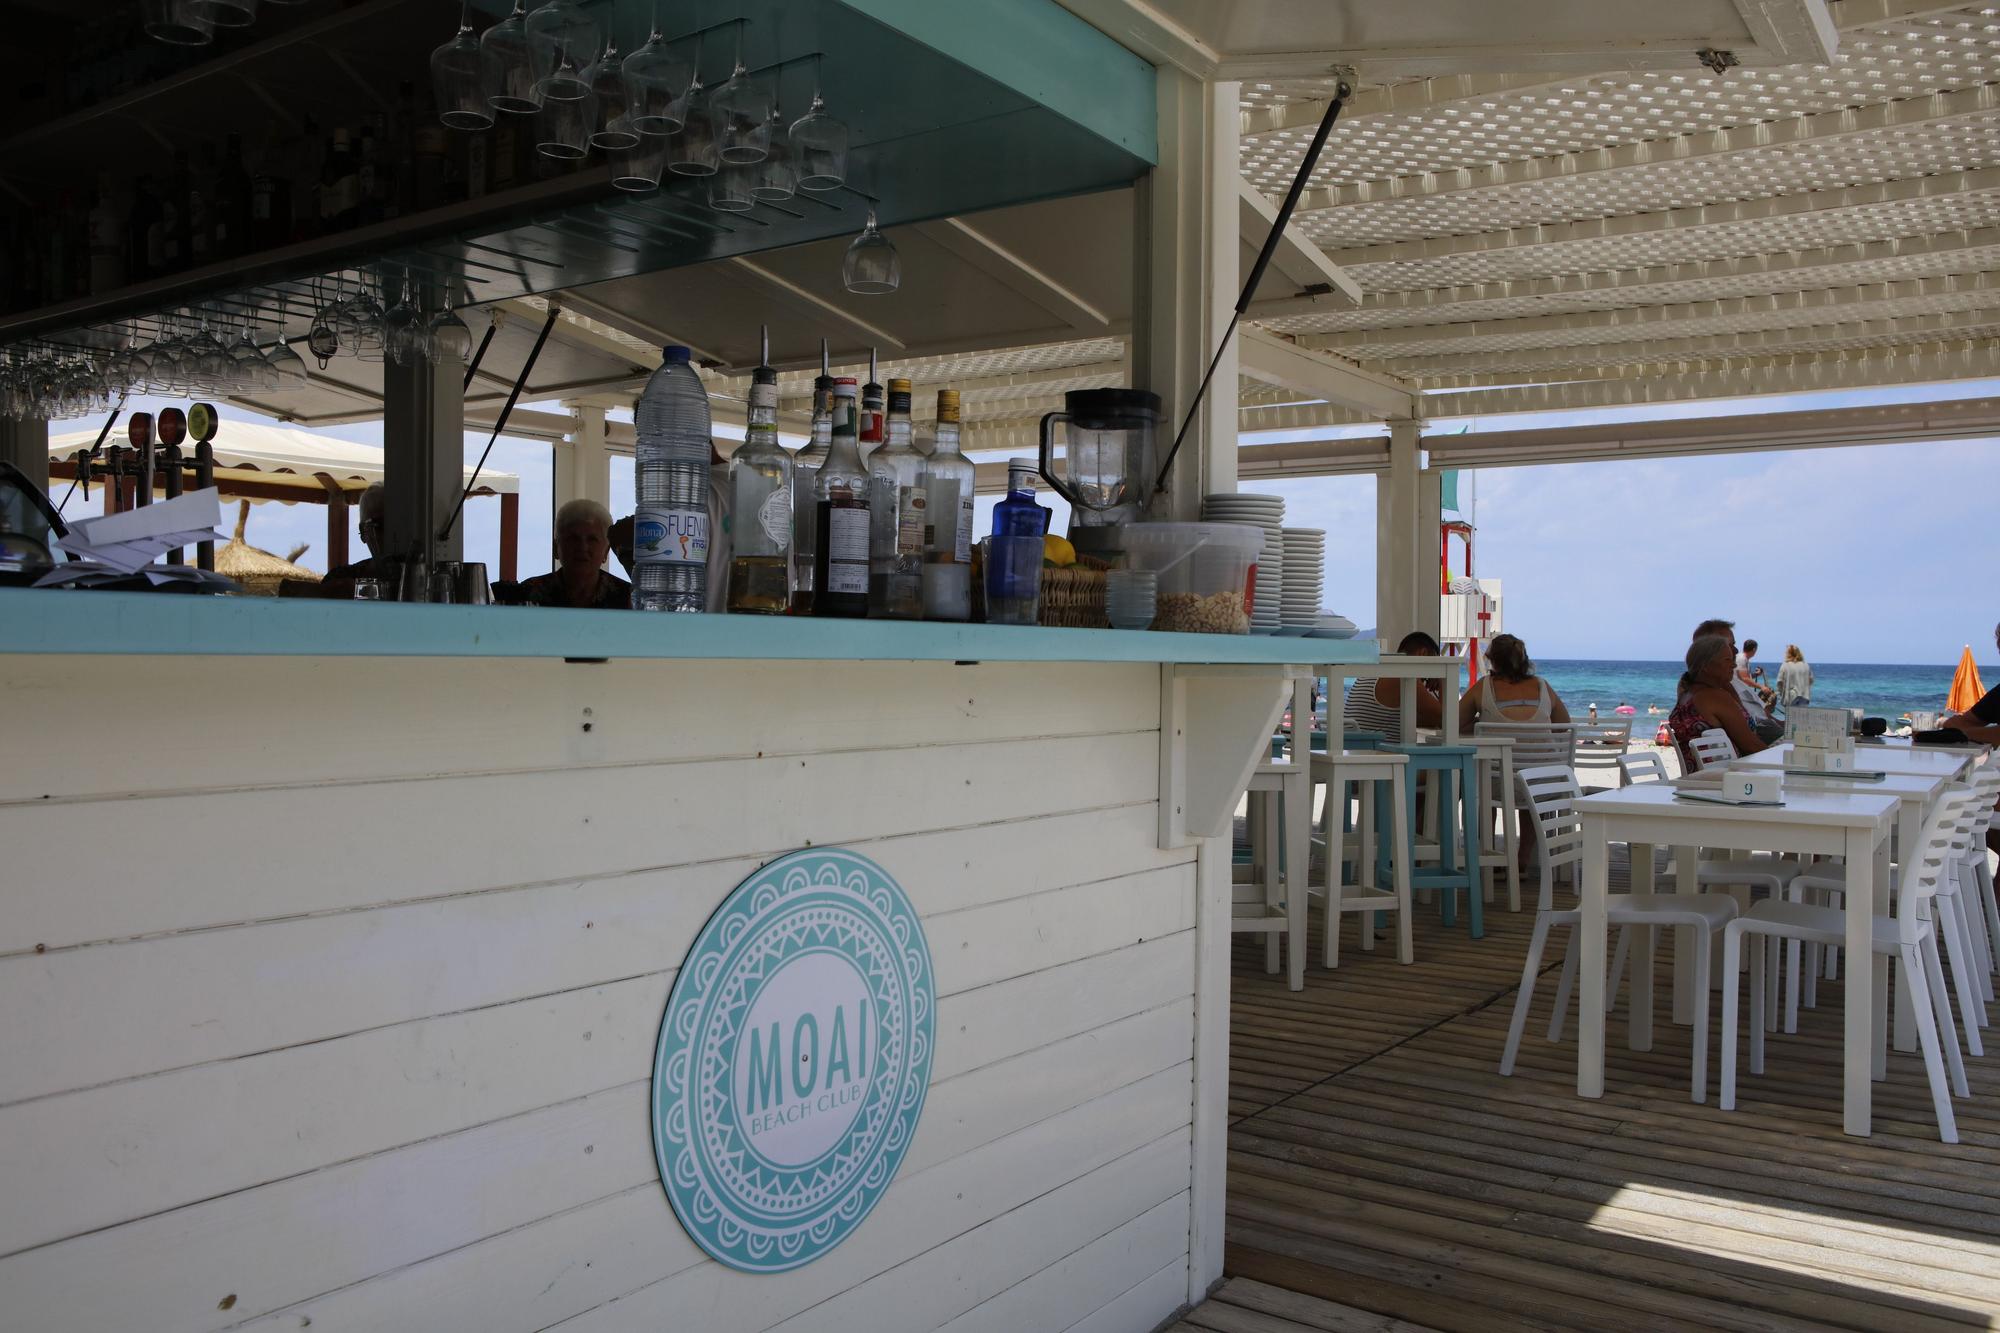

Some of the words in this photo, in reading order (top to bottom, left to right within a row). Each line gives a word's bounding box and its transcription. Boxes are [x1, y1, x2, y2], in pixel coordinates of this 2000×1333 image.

[1744, 783, 1753, 796] 9
[746, 998, 867, 1116] MOAI
[751, 1100, 811, 1136] BEACH
[817, 1084, 861, 1113] CLUB
